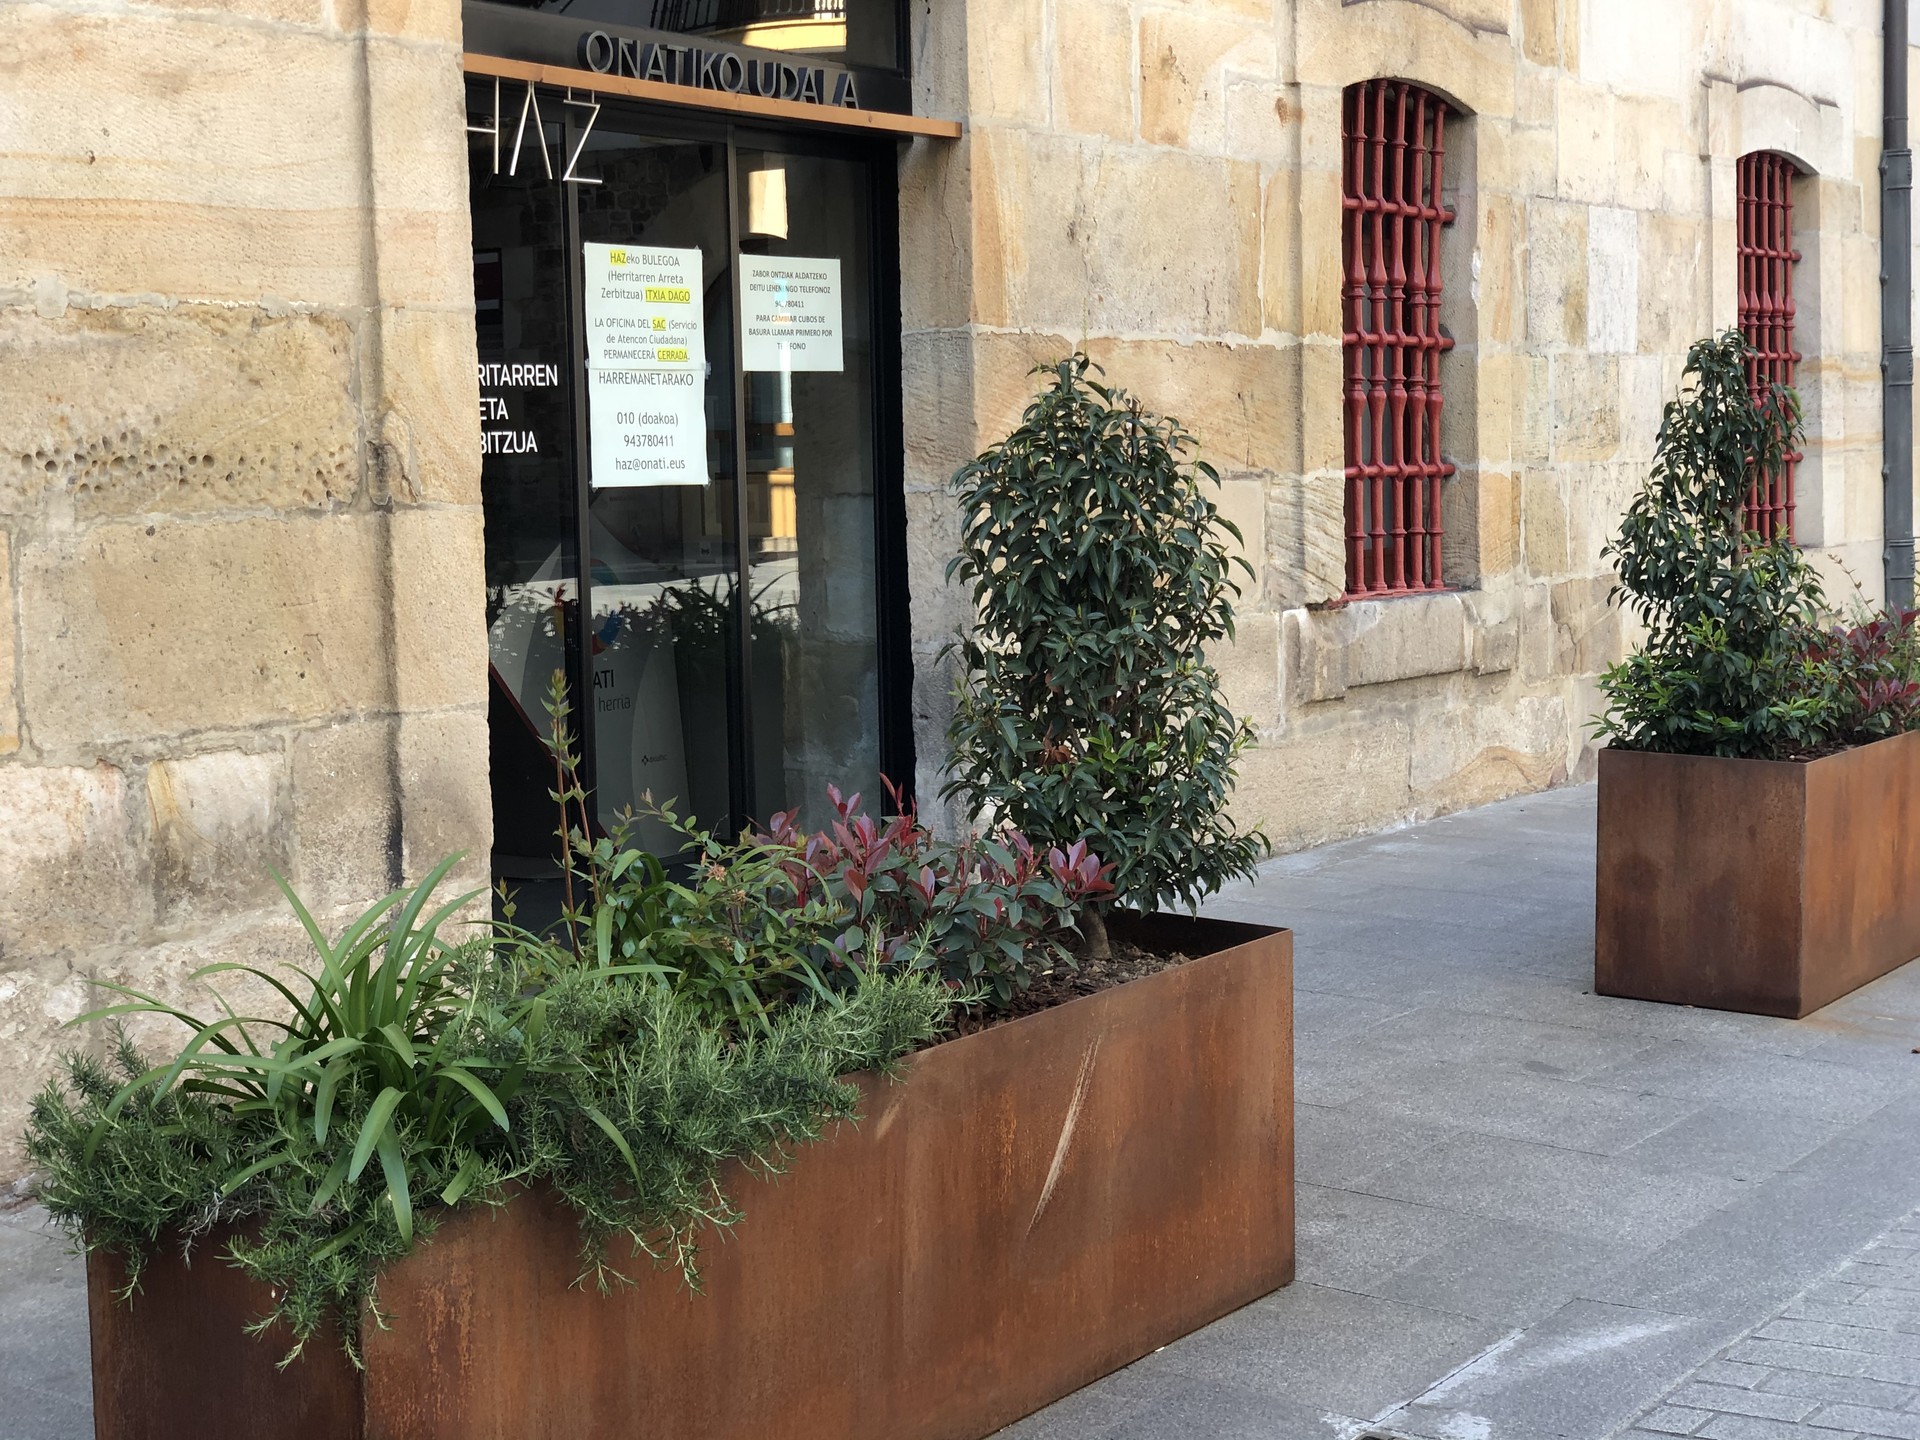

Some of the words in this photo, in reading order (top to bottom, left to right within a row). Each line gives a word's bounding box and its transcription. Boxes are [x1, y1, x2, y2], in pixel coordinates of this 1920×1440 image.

[610, 252, 640, 265] HAZeko
[642, 254, 680, 266] BULEGOA
[607, 270, 656, 283] (Herritarren
[657, 273, 684, 284] Arreta
[752, 269, 770, 278] ZABOR
[770, 271, 794, 279] ONTZIAK
[794, 272, 828, 281] ALDATZEKO
[601, 287, 643, 301] Zerbitzua)
[645, 289, 666, 303] ITXIA
[668, 290, 691, 304] DAGO
[749, 283, 766, 292] DEITU
[799, 286, 831, 294] TELEFONOZ
[594, 318, 605, 328] LA
[606, 317, 636, 328] OFICINA
[637, 319, 651, 329] DEL
[652, 319, 667, 331] SAC
[668, 319, 698, 330] (Servicio
[755, 314, 771, 323] PARA
[798, 315, 818, 324] CUBOS
[818, 316, 826, 324] DE
[748, 328, 771, 336] BASURA
[771, 328, 795, 337] LLAMAR
[795, 329, 821, 337] PRIMERO
[821, 329, 833, 337] POR
[606, 334, 617, 344] de
[649, 334, 688, 346] Ciudadana)
[603, 348, 656, 360] PERMANECERÁ
[598, 371, 694, 386] HARREMANETARAKO
[616, 411, 635, 425] 010
[638, 411, 679, 427] (doakoa)
[623, 434, 674, 448] 943780411
[615, 457, 685, 471] haz@onati.eus
